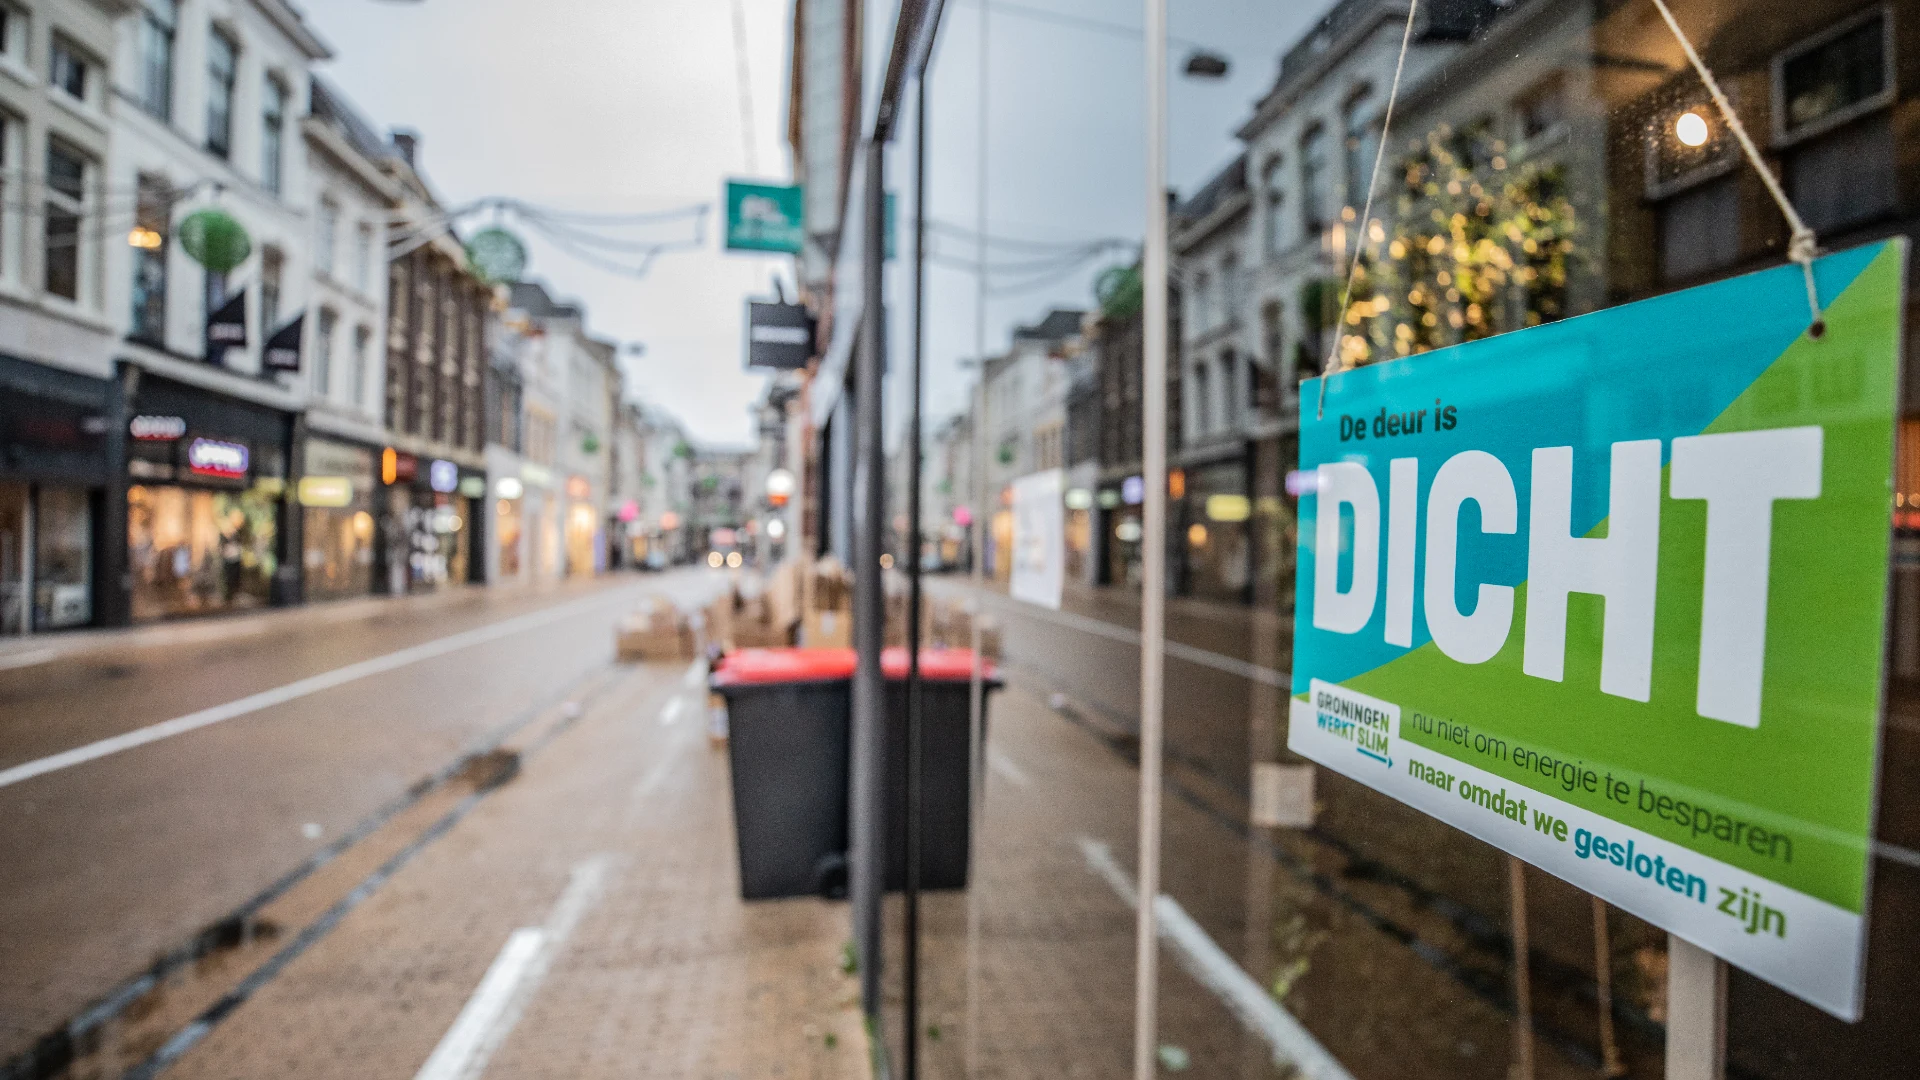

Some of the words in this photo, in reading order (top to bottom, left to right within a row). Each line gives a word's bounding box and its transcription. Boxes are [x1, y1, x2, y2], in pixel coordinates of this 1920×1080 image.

[1340, 414, 1366, 442] De
[1373, 407, 1426, 438] deur
[1434, 398, 1458, 432] is
[1313, 425, 1823, 729] DICHT
[1316, 711, 1355, 742] WERKT
[1357, 727, 1389, 756] SLIM
[1317, 690, 1390, 733] GRONINGEN
[1412, 712, 1433, 735] nu
[1437, 718, 1470, 748] niet
[1474, 733, 1507, 761] om
[1513, 746, 1598, 792] energie
[1604, 772, 1631, 805] te
[1638, 779, 1793, 864] besparen
[1408, 758, 1455, 793] maar
[1459, 780, 1528, 826] omdat
[1533, 808, 1568, 843] we
[1574, 827, 1707, 904] gesloten
[1717, 886, 1787, 939] zijn
